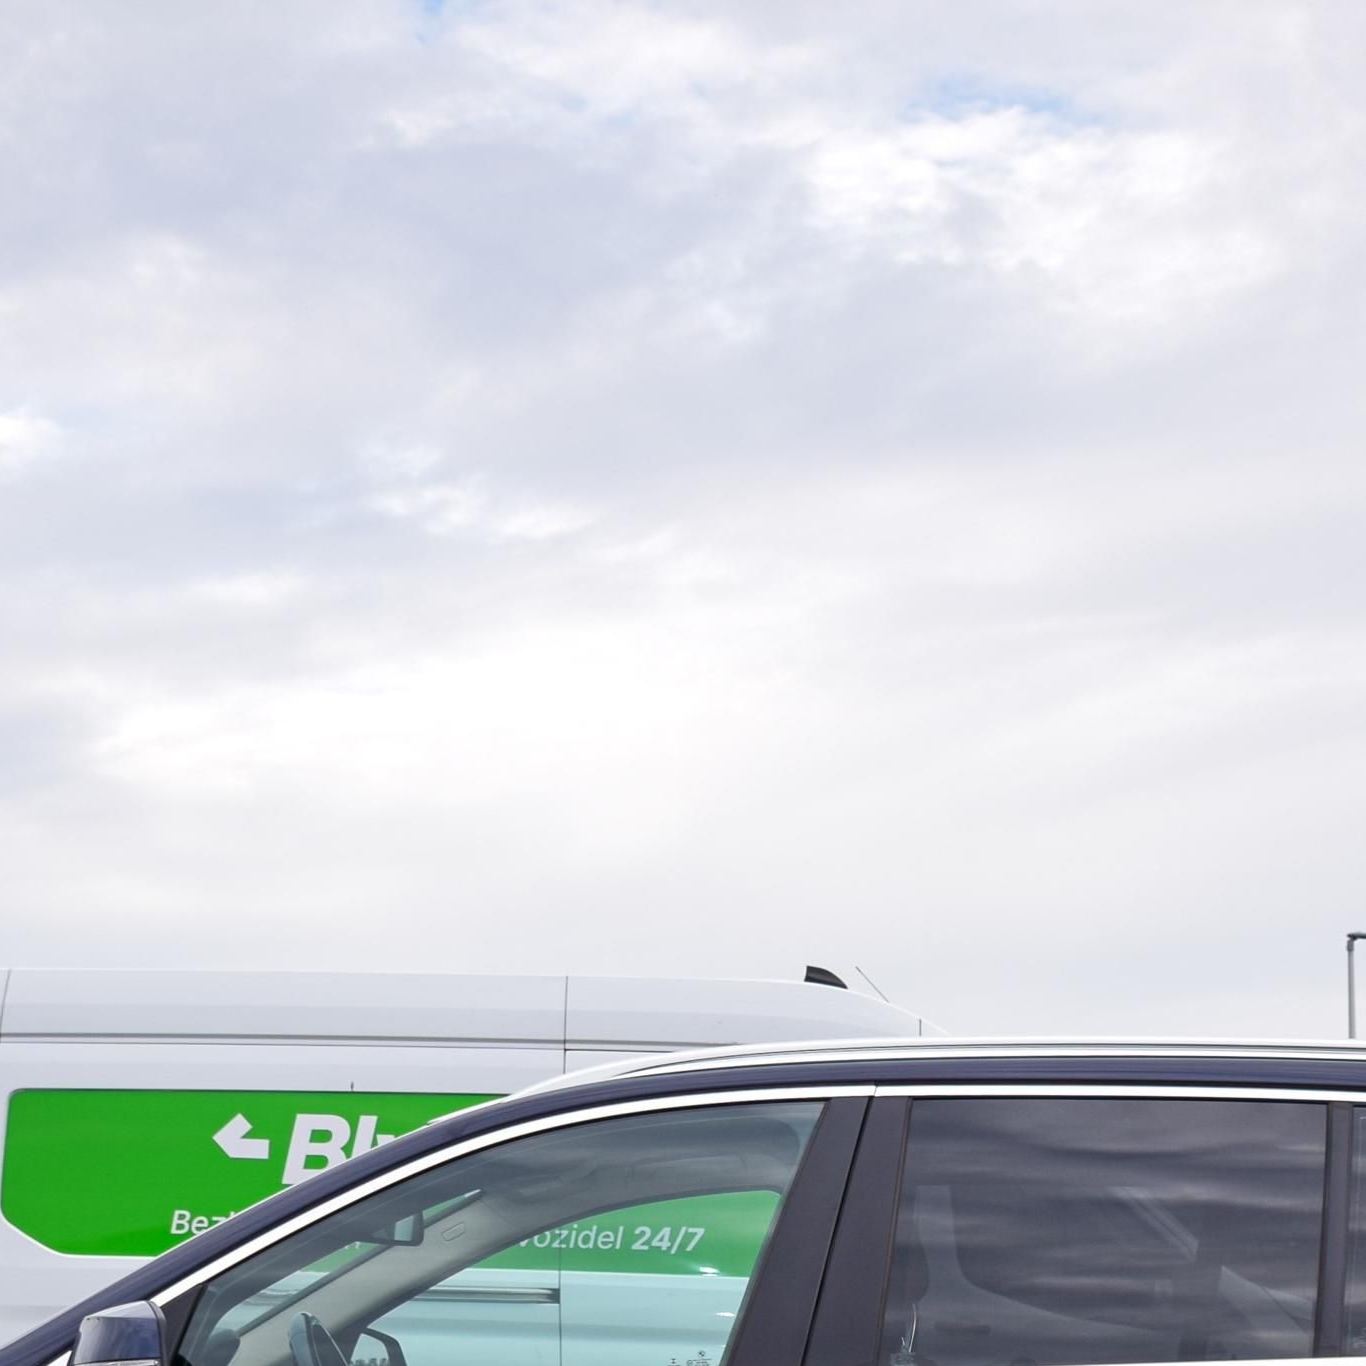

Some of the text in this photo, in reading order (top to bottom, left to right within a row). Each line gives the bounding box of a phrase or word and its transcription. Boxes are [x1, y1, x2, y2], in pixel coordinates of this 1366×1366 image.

[281, 1113, 398, 1185] Bl
[518, 1223, 624, 1250] ozidel
[631, 1225, 706, 1255] 24/7
